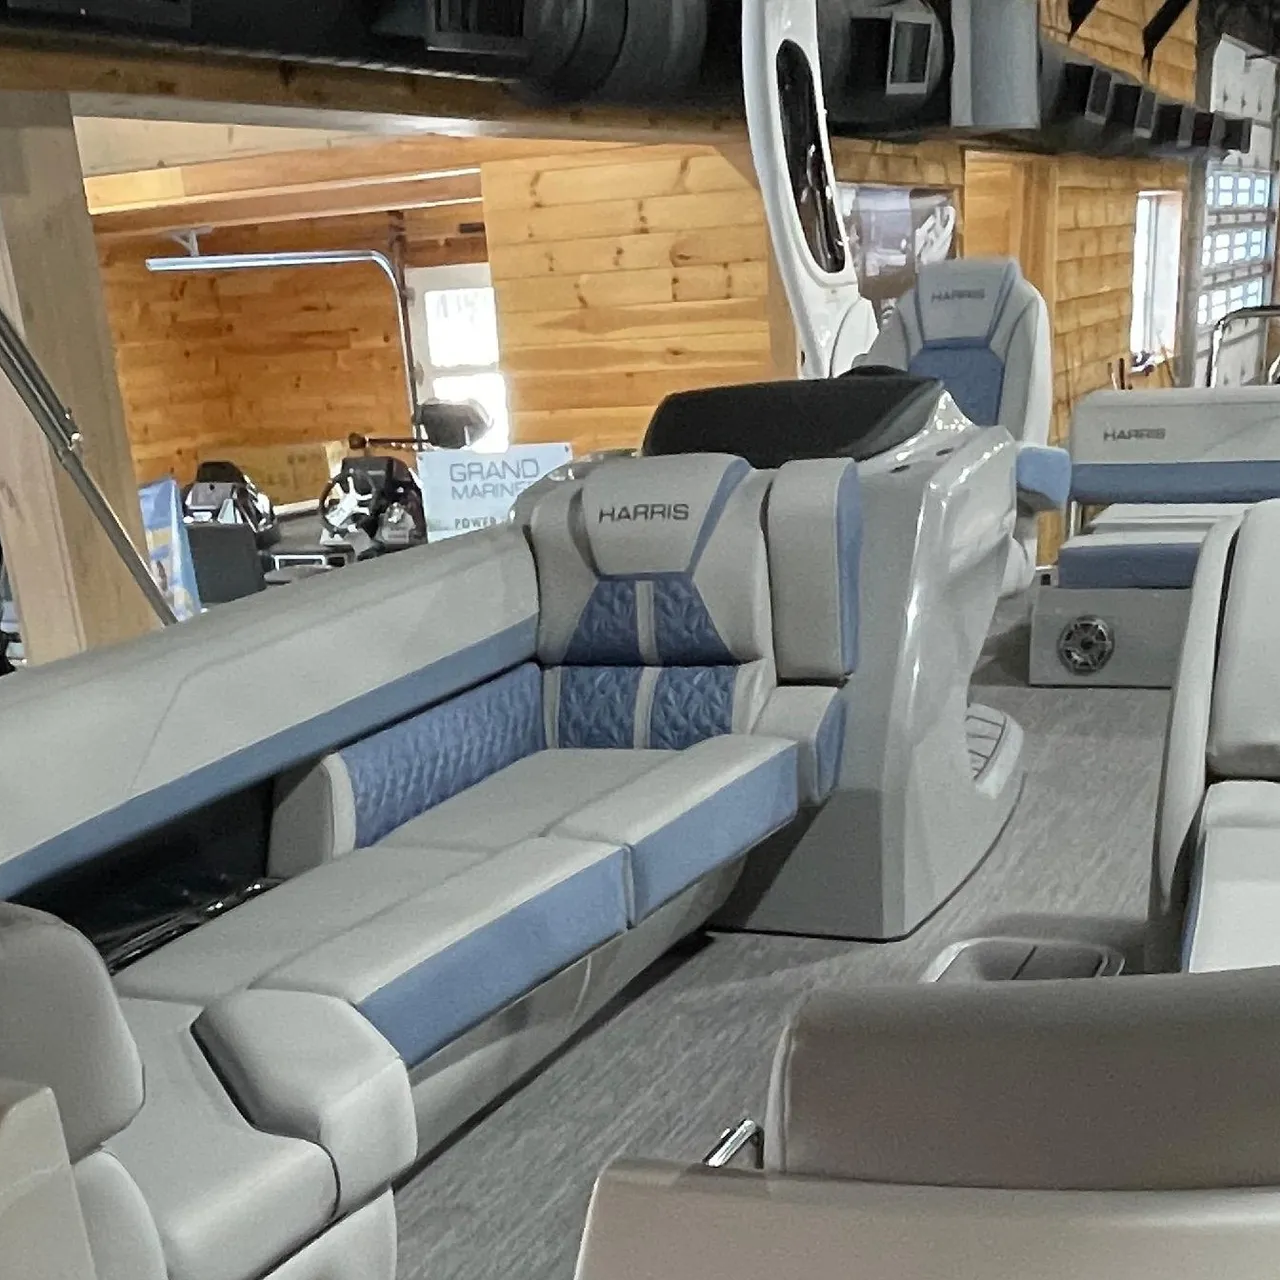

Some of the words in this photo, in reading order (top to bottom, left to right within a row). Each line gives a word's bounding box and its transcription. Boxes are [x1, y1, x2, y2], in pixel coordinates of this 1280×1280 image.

[1103, 428, 1166, 442] HARRIS
[449, 458, 540, 482] GRAND
[599, 503, 690, 523] HARRIS
